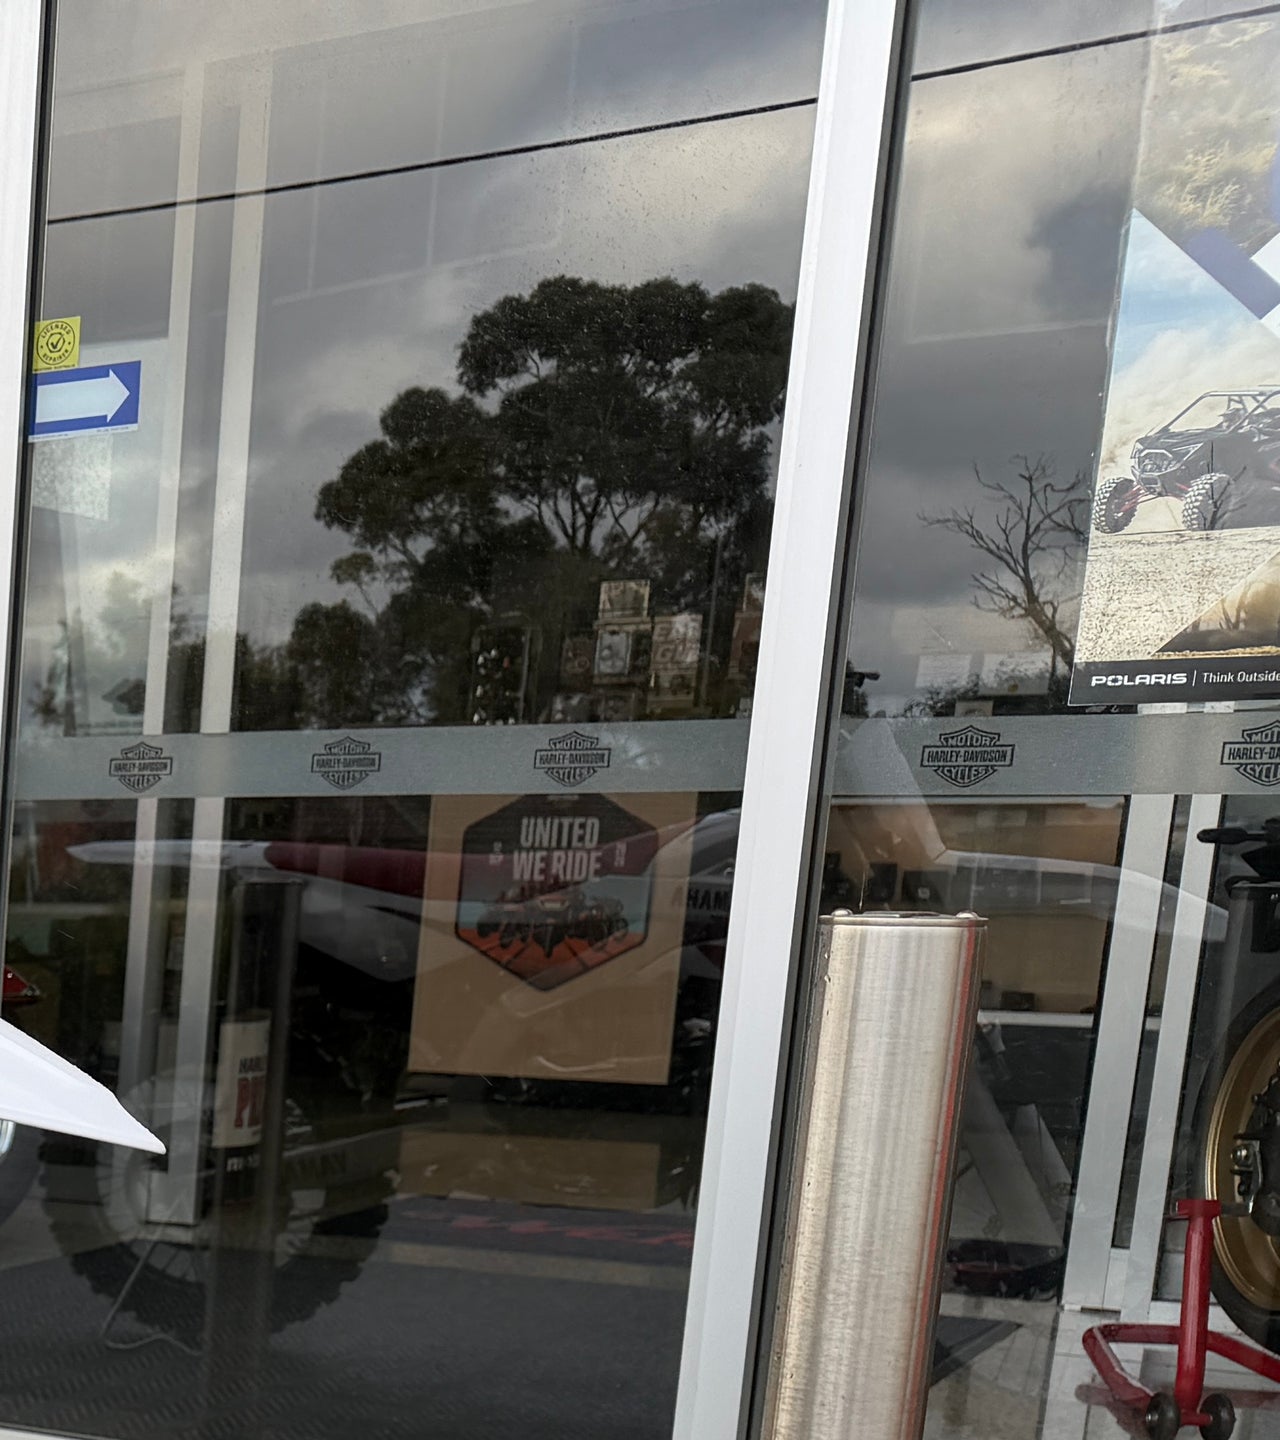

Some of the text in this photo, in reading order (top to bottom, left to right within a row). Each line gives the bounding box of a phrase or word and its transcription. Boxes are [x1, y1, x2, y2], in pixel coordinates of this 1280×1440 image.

[1091, 673, 1187, 687] POLARIS
[1203, 671, 1234, 684] Think
[945, 735, 997, 748] MOTOR
[926, 747, 1008, 764] HARLEY-DAVIDSON
[942, 766, 989, 781] CYCLES
[520, 816, 600, 850] UNITED
[512, 850, 548, 882] WE
[550, 849, 603, 884] RIDE
